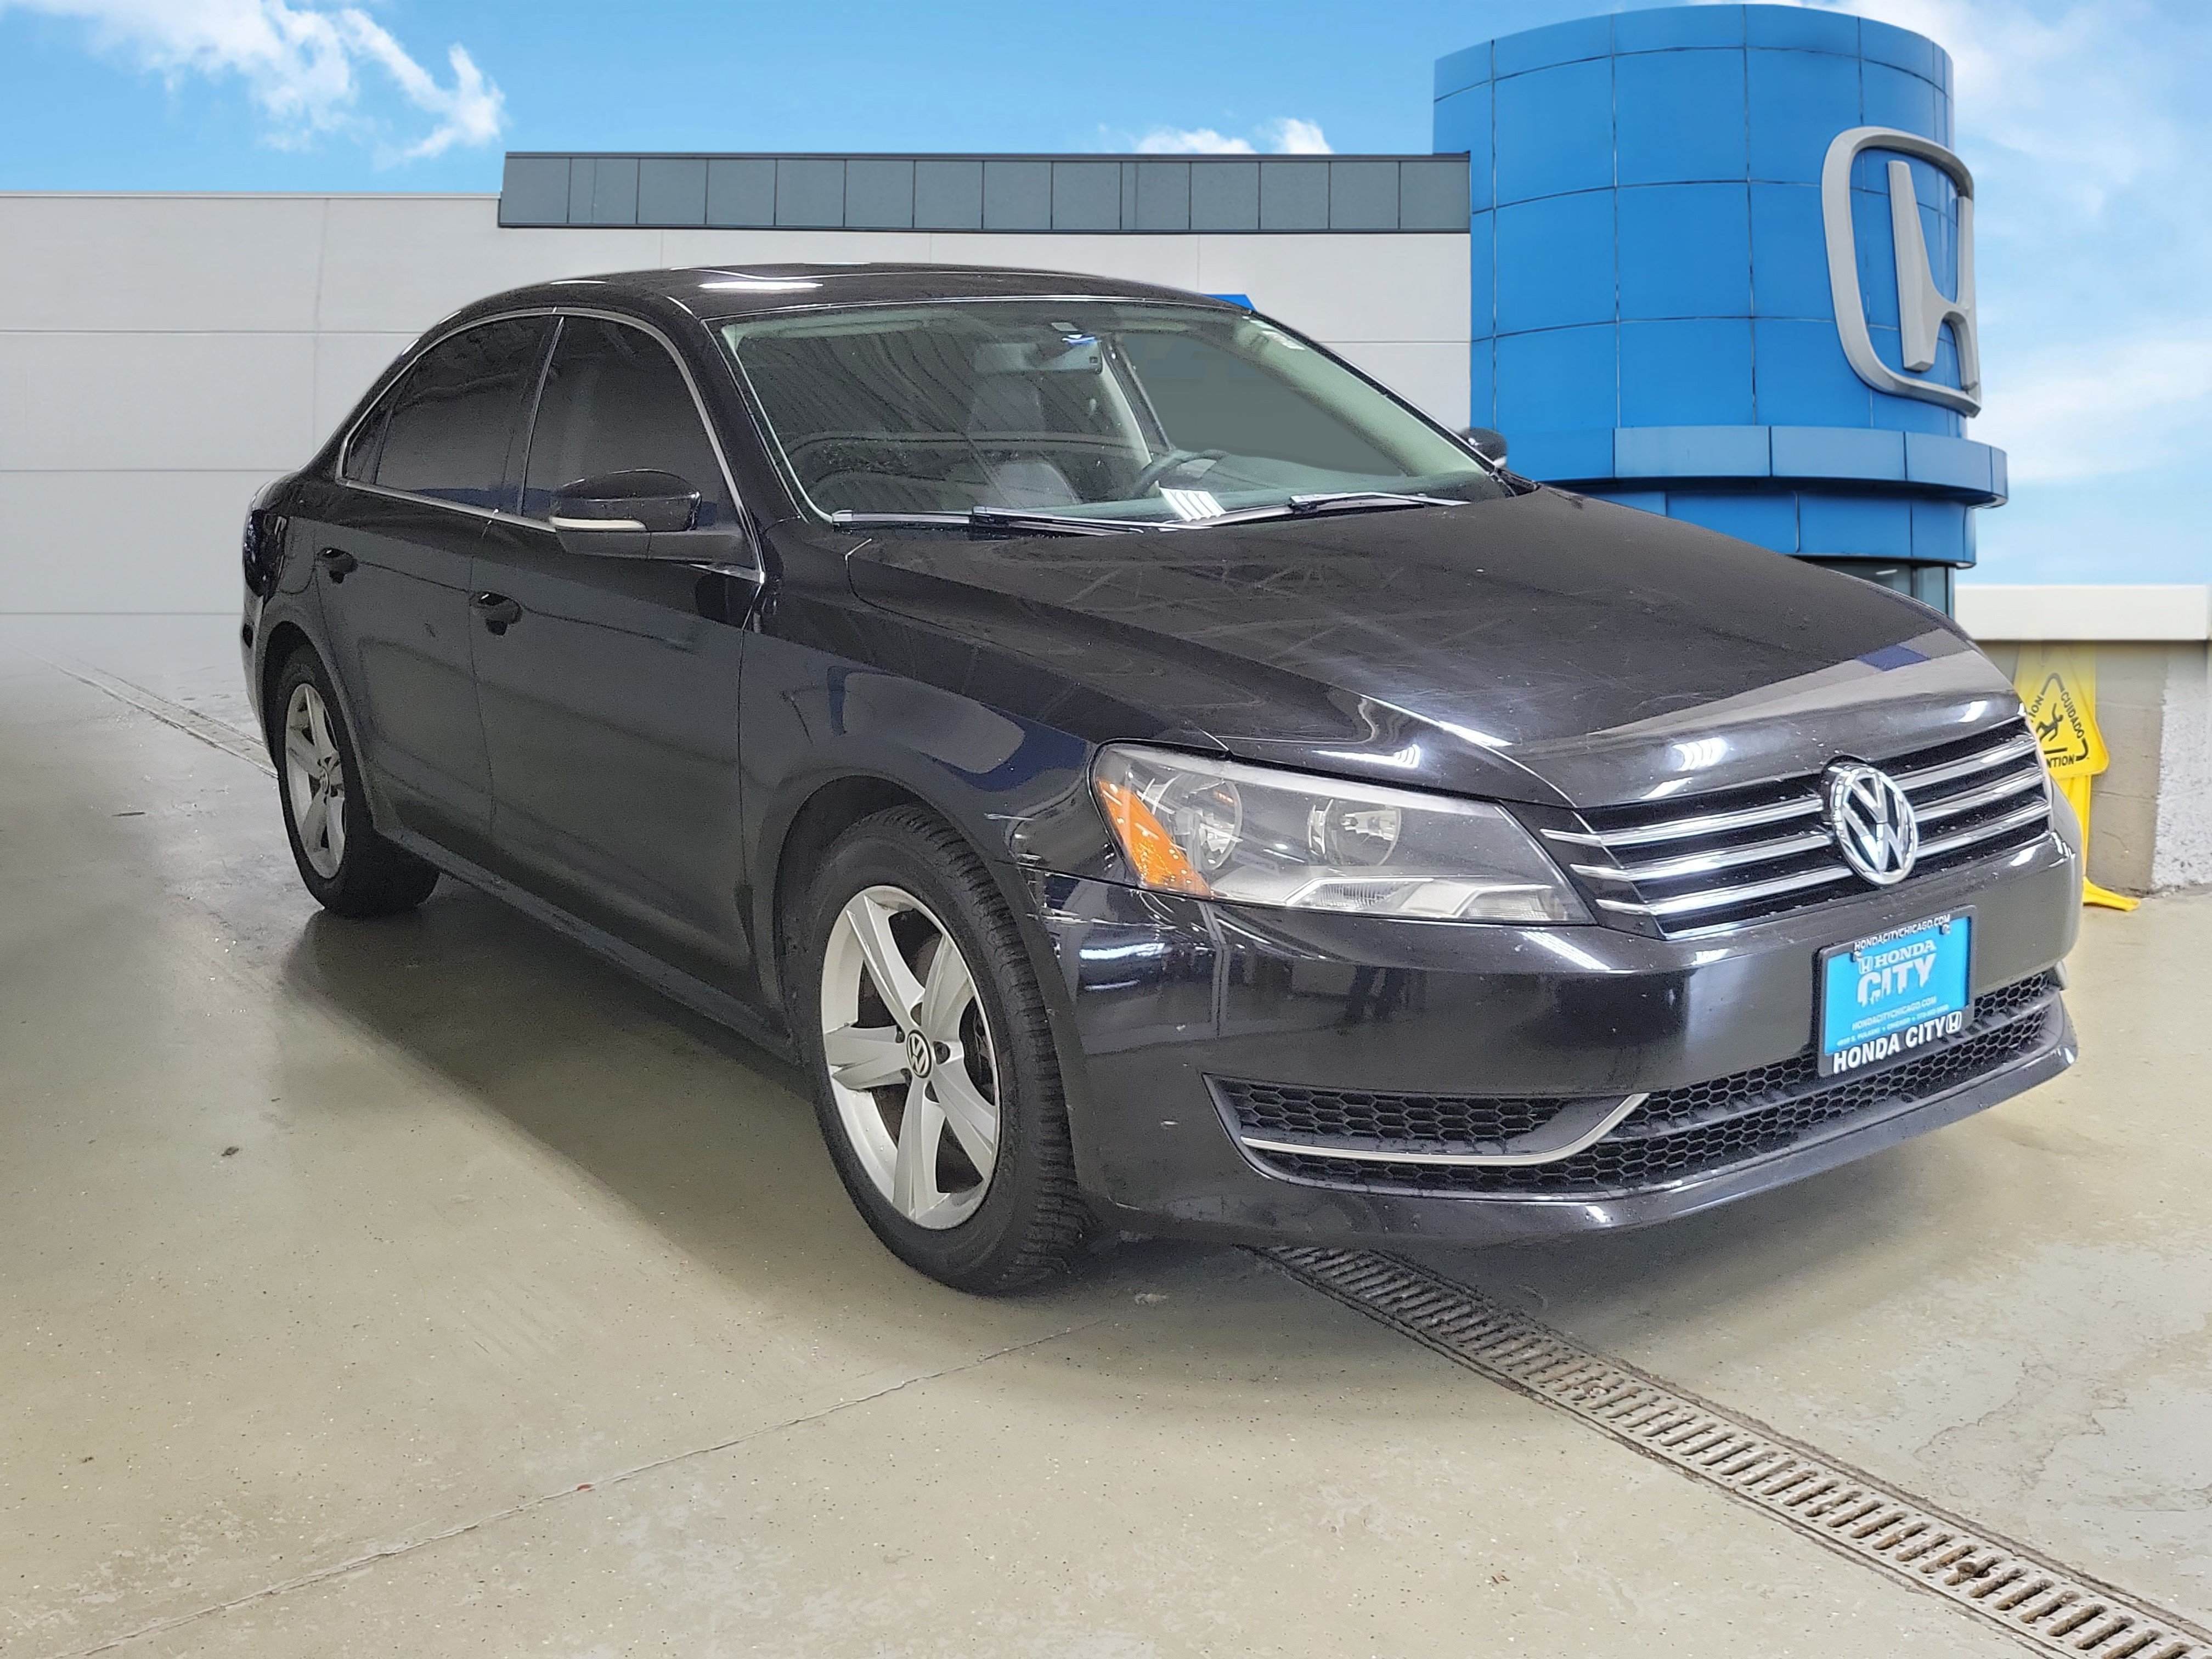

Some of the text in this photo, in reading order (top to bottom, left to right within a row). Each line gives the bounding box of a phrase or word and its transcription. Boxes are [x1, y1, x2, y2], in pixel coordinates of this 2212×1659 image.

[2061, 692, 2085, 739] CUIDADO
[1854, 914, 1950, 951] HONDACITYCHICAGO.COM
[1874, 940, 1937, 966] HONDA
[1857, 953, 1937, 1007] CITY
[1833, 1033, 1900, 1074] HONDA
[1905, 1015, 1946, 1048] CITY
